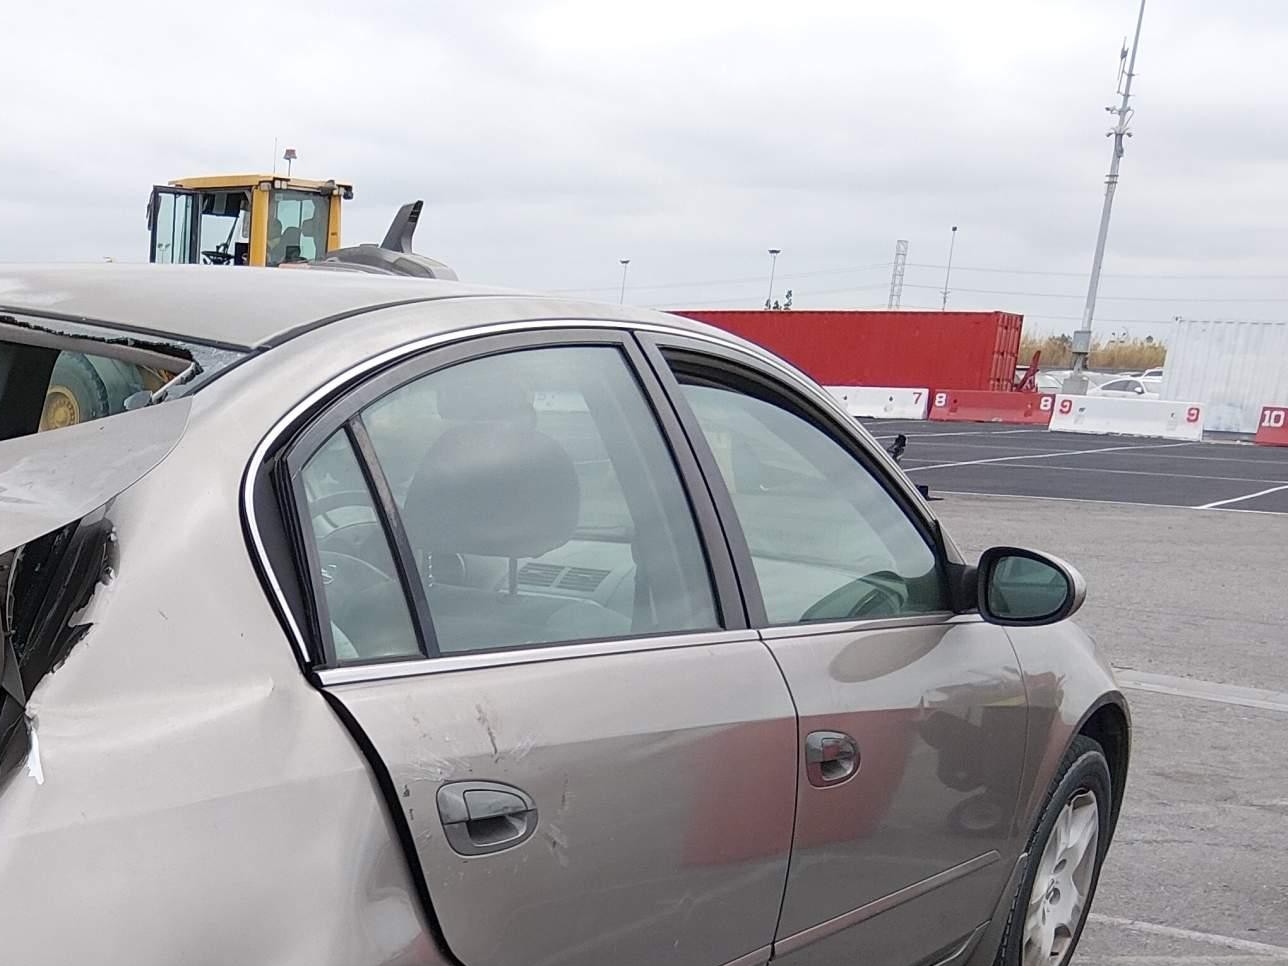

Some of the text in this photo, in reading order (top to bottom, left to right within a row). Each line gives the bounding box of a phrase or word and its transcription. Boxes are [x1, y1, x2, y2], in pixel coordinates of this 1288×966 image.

[912, 392, 923, 405] 7
[934, 392, 947, 407] 8
[1039, 396, 1053, 411] 8
[1059, 399, 1073, 415] 9
[1186, 407, 1200, 423] 9
[1261, 410, 1286, 427] 10
